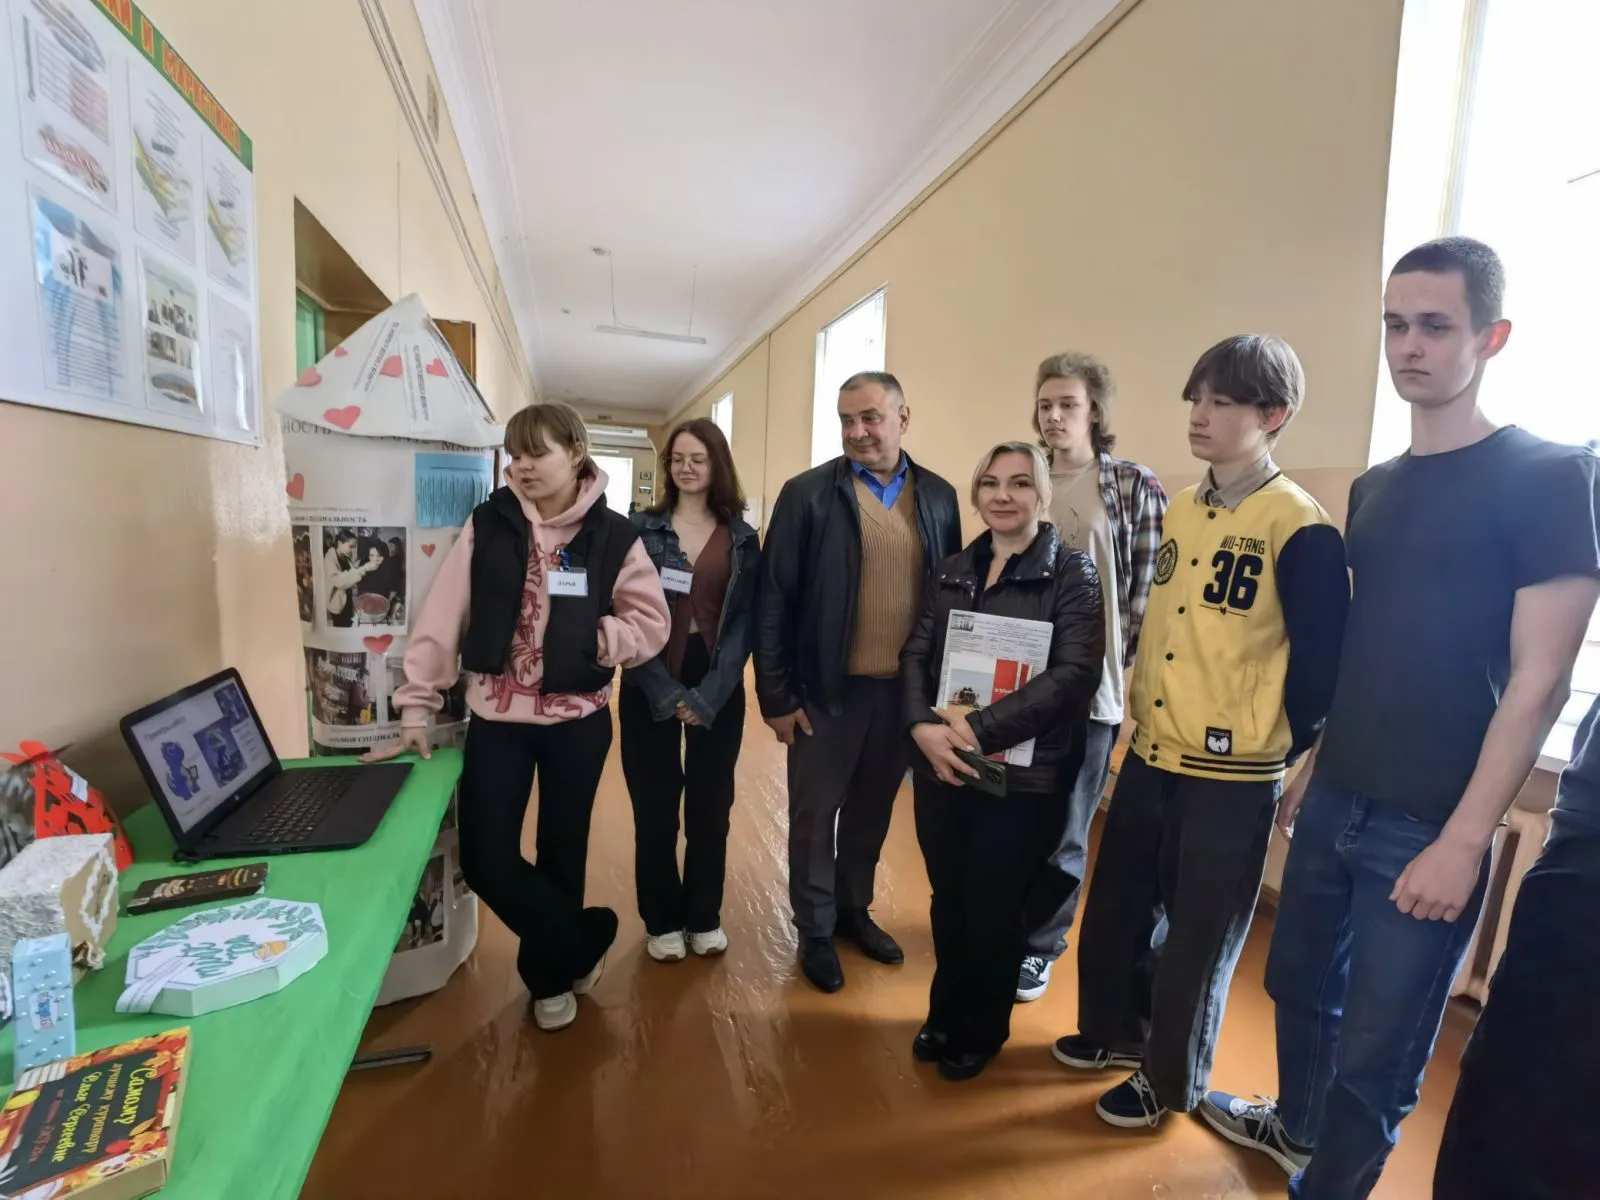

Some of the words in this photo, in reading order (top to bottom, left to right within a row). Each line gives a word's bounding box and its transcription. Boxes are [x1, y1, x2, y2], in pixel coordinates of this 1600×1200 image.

[1220, 535, 1265, 555] WU-TANG
[1203, 549, 1264, 611] 36
[100, 1063, 123, 1101] лучшему
[113, 1067, 157, 1125] Самому
[51, 1103, 91, 1163] Сергеевне
[81, 1104, 110, 1153] куратору
